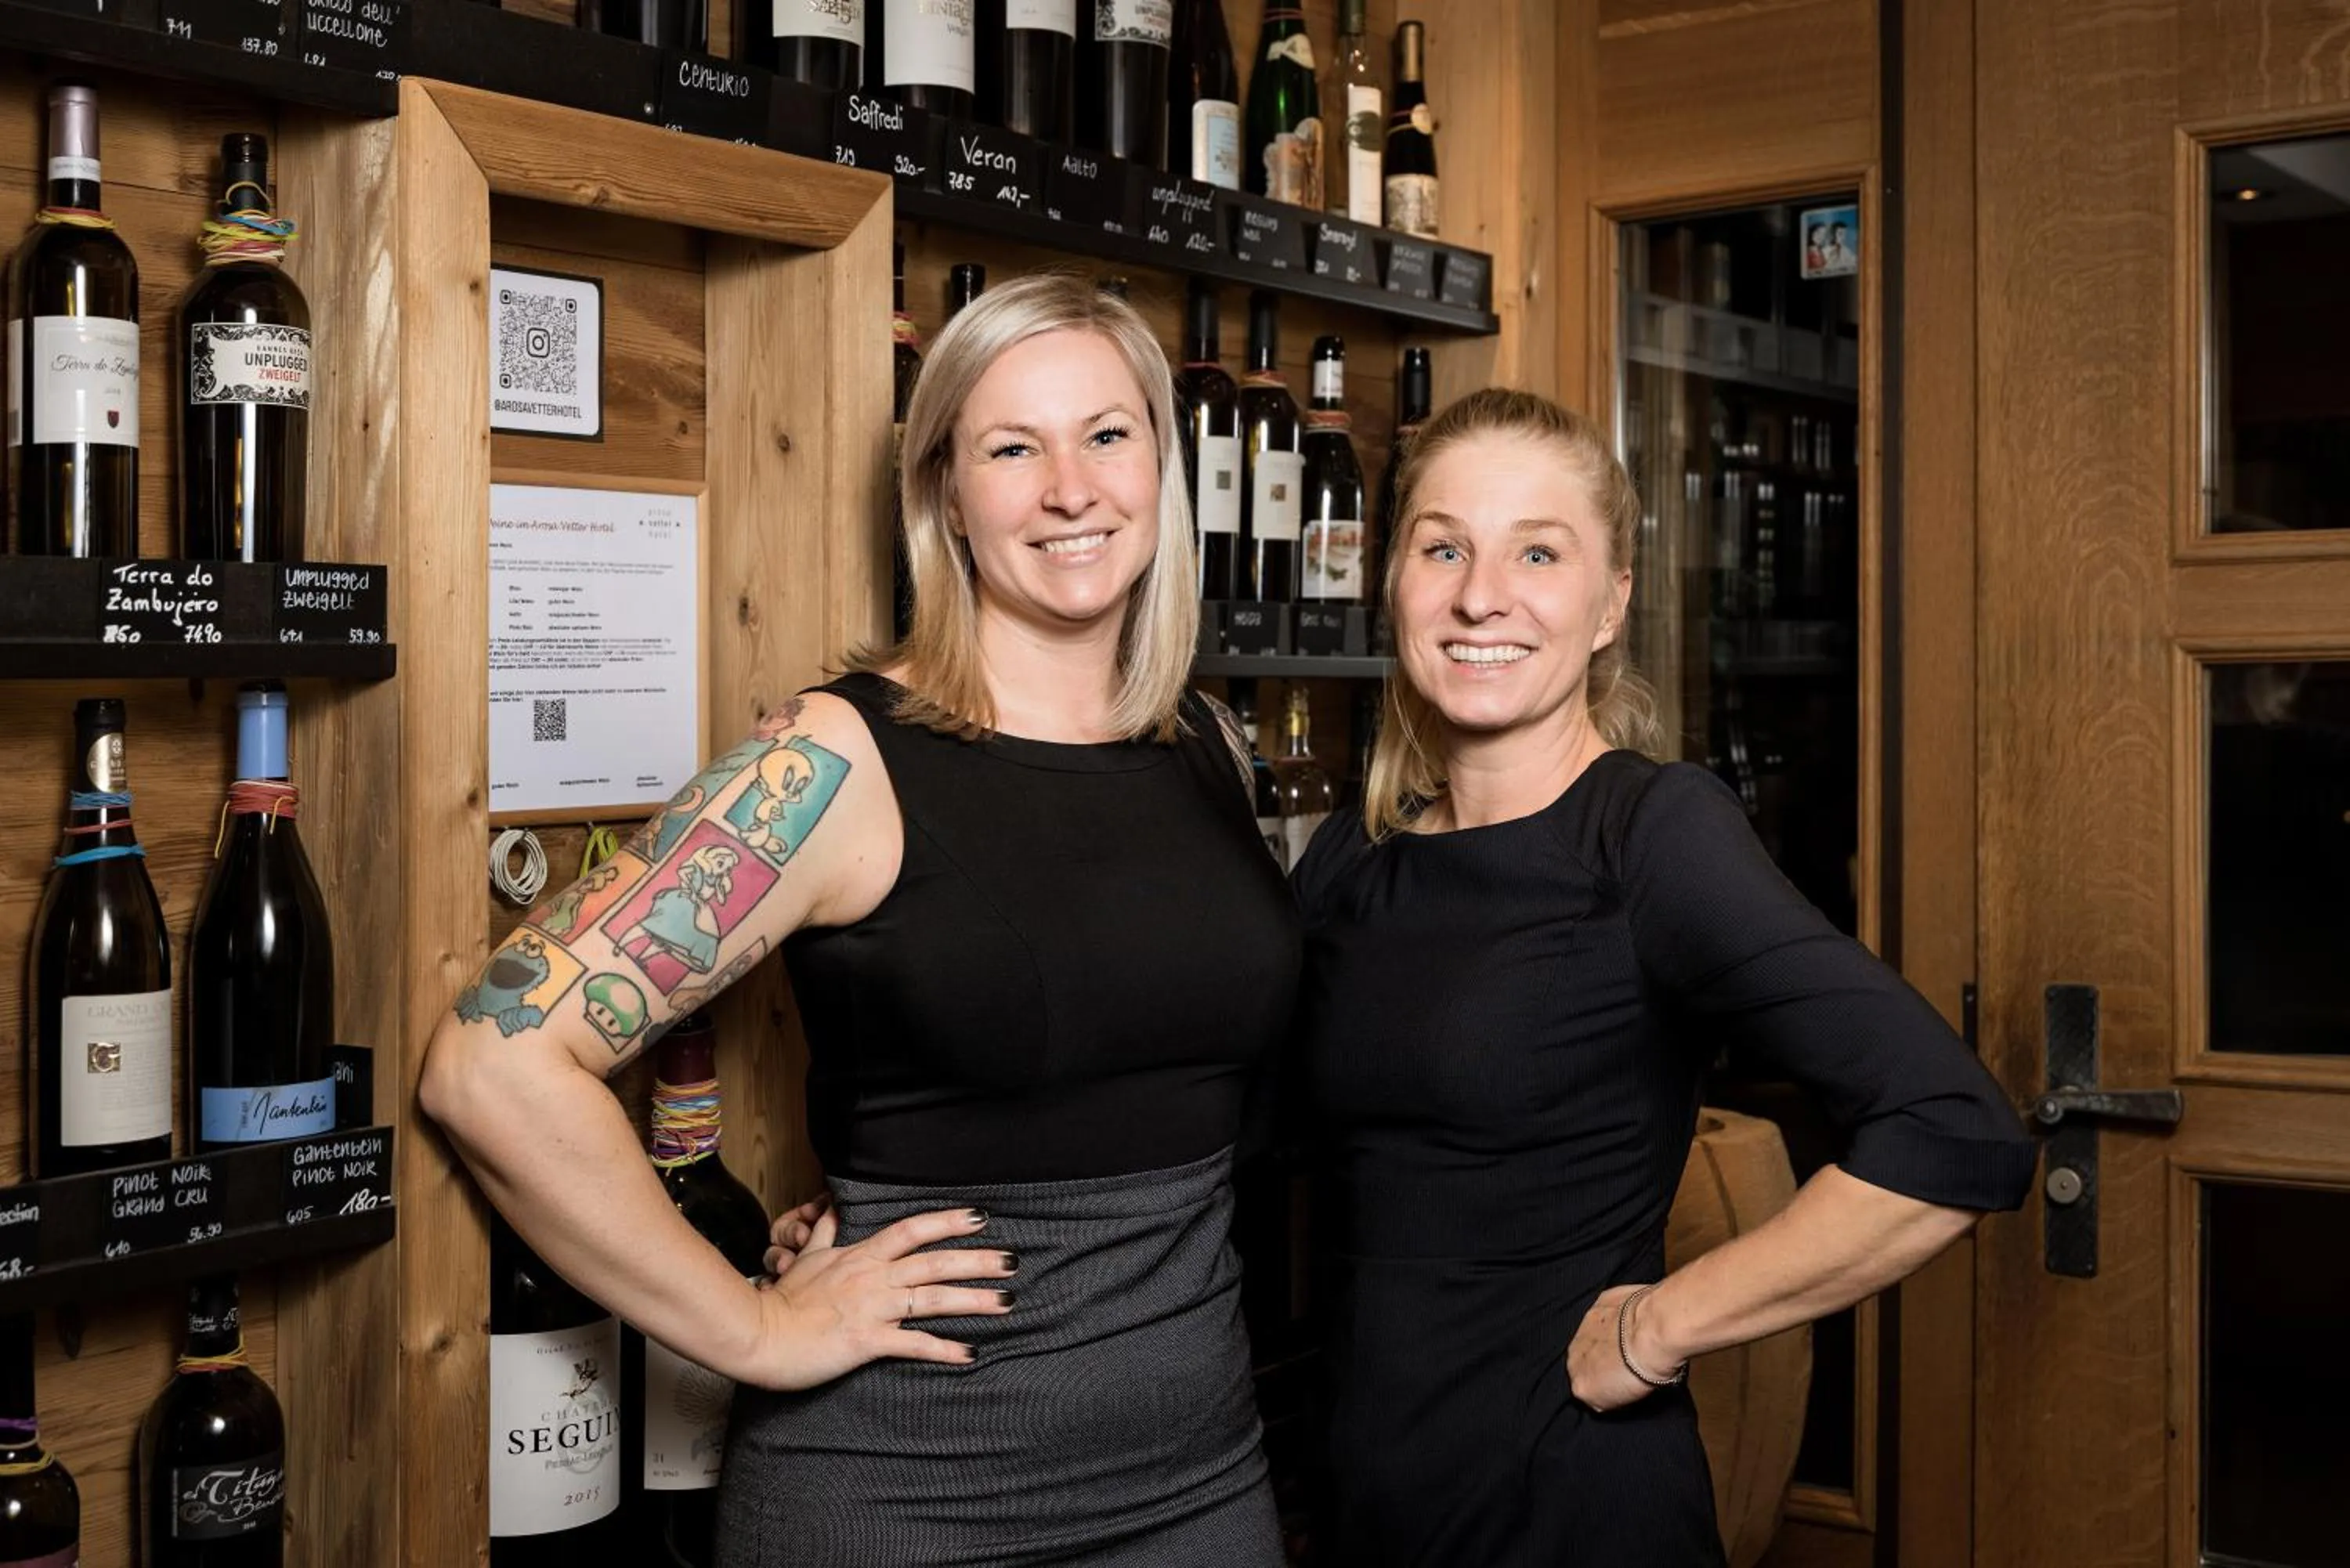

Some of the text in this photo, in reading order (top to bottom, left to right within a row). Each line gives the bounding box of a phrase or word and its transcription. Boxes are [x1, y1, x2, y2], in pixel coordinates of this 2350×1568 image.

[166, 18, 192, 39] 711
[848, 94, 903, 131] Saffredi
[960, 134, 1017, 174] Veran
[949, 171, 975, 190] 785
[245, 352, 308, 372] UNPLUGGED
[258, 368, 302, 383] ZWEIGELT
[113, 563, 213, 586] Terra do
